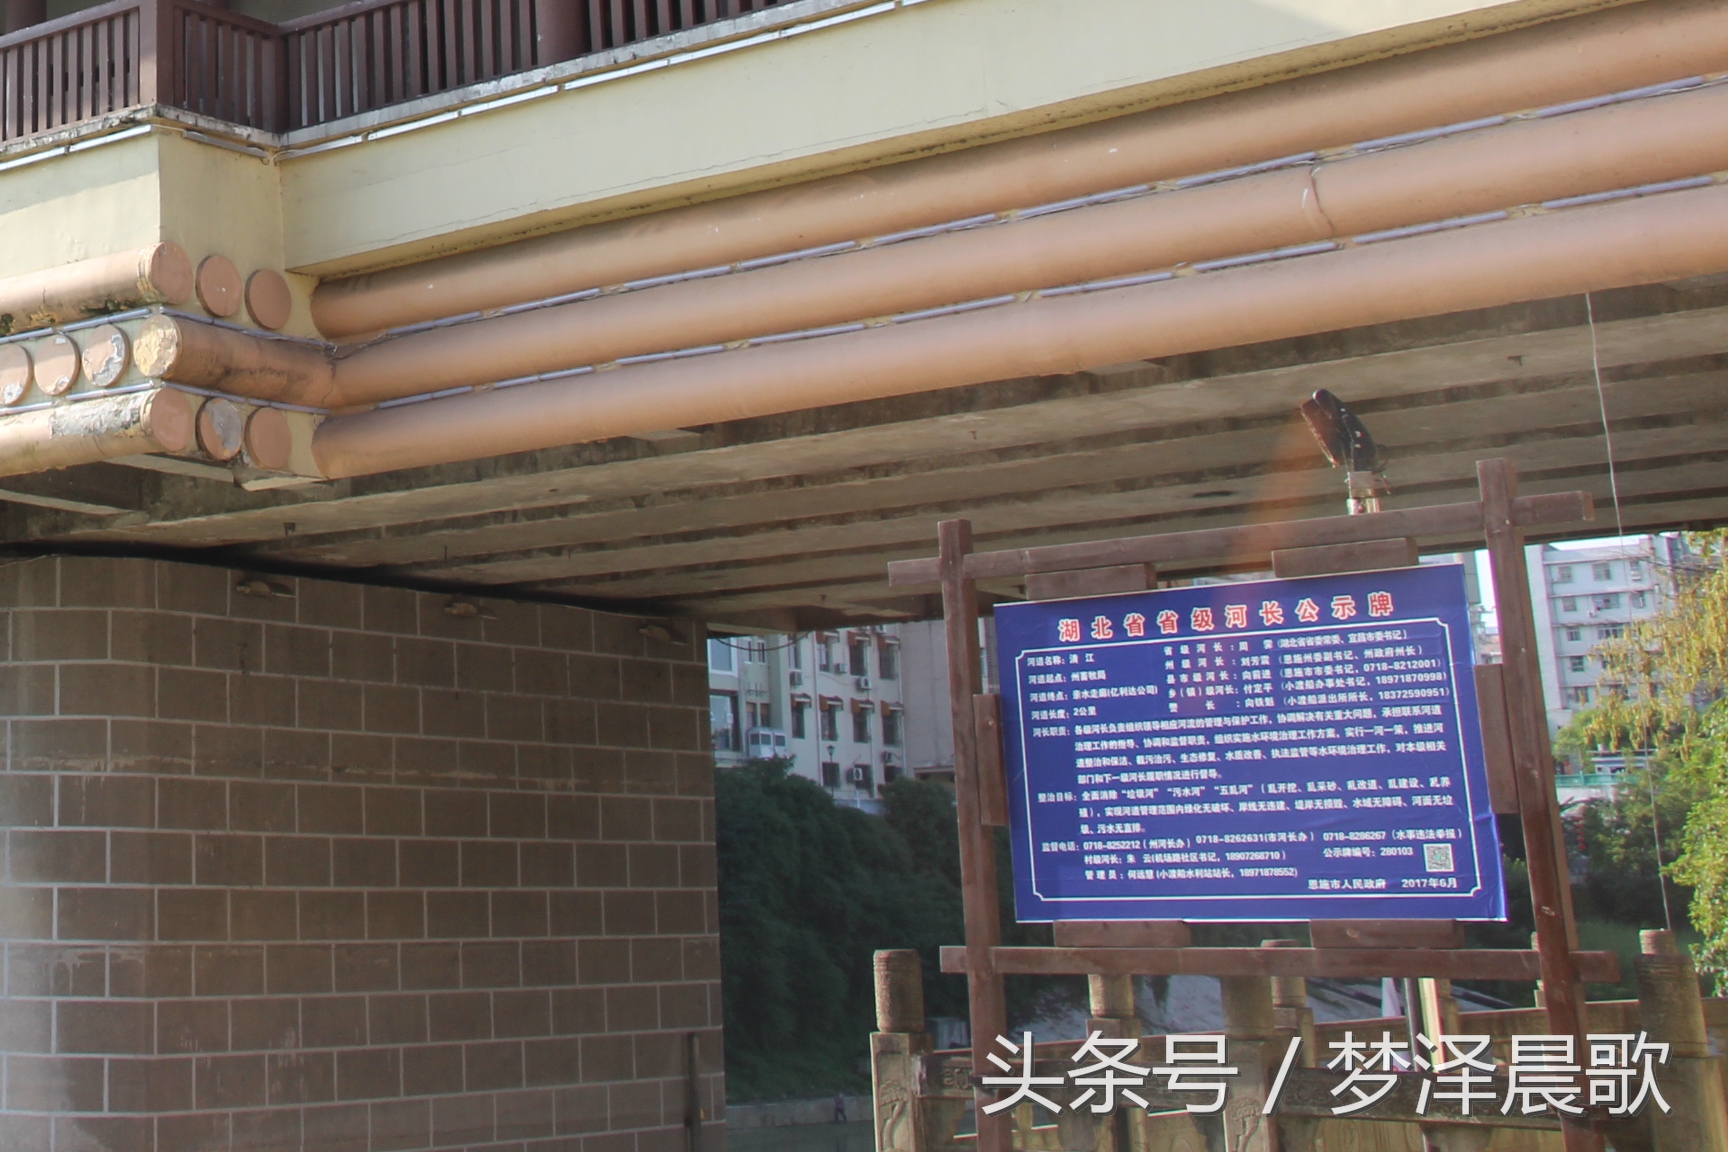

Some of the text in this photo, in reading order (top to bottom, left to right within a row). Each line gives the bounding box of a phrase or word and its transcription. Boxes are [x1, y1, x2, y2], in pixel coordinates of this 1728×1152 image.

[1058, 591, 1393, 642] 湖北省省级河长公示牌
[1307, 877, 1458, 890] 恩施市人民政府 2017年6月
